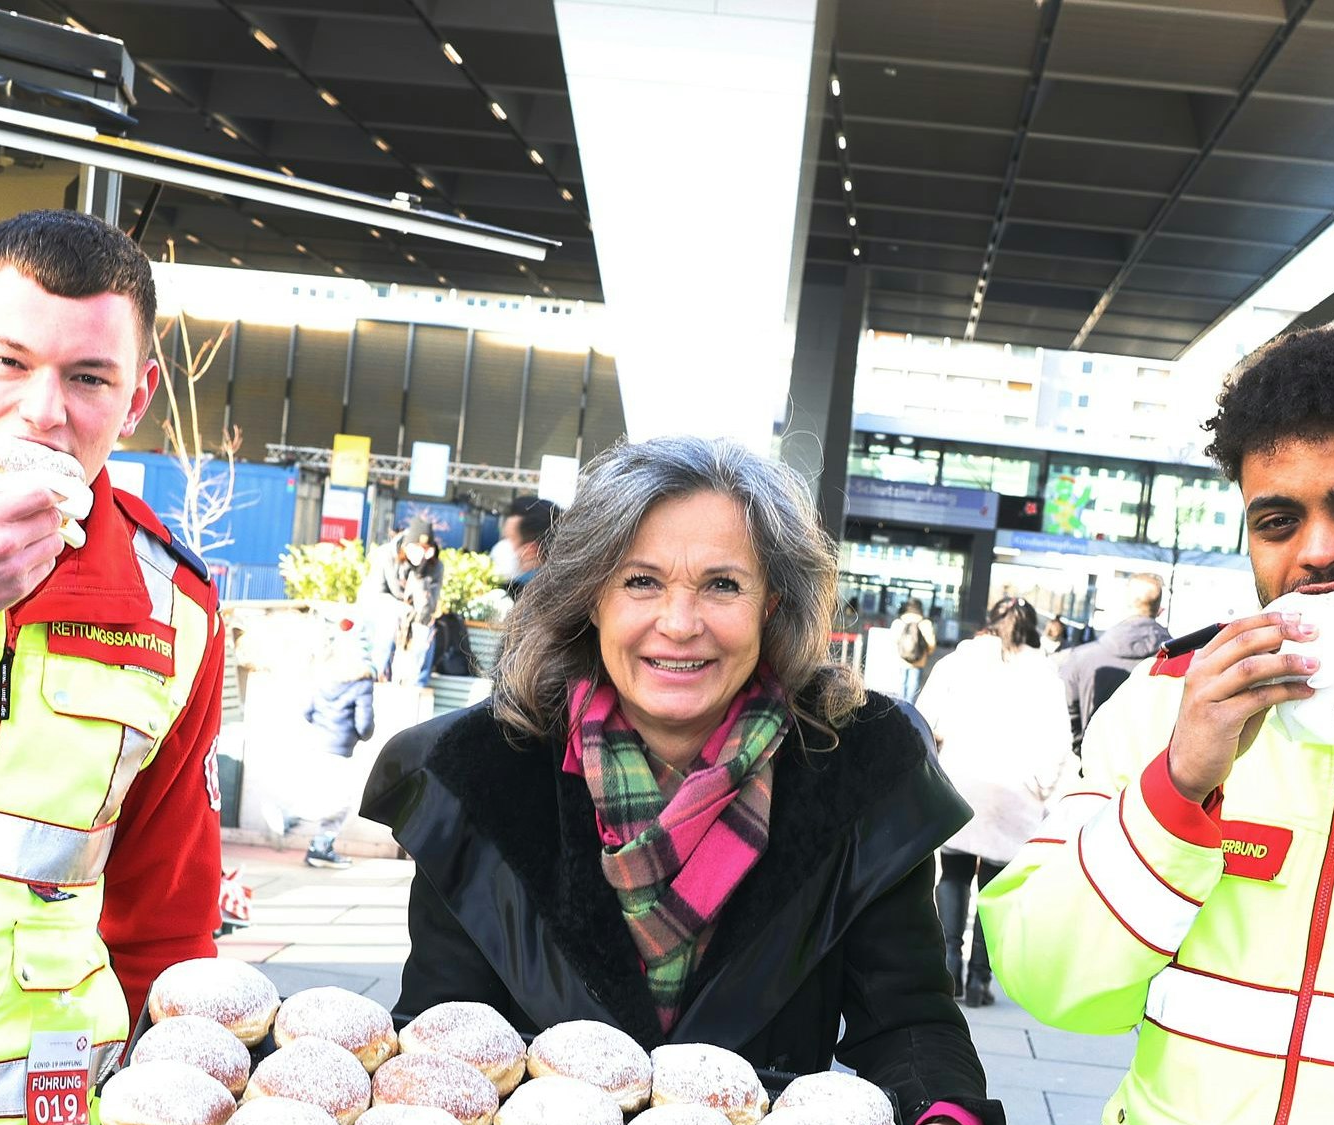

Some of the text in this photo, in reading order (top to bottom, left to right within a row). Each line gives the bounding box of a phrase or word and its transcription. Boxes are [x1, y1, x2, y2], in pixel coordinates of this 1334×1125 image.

[52, 621, 174, 659] RETTUNGSSANITÄTER
[32, 1074, 82, 1092] FÜHRUNG
[34, 1093, 79, 1124] 019
